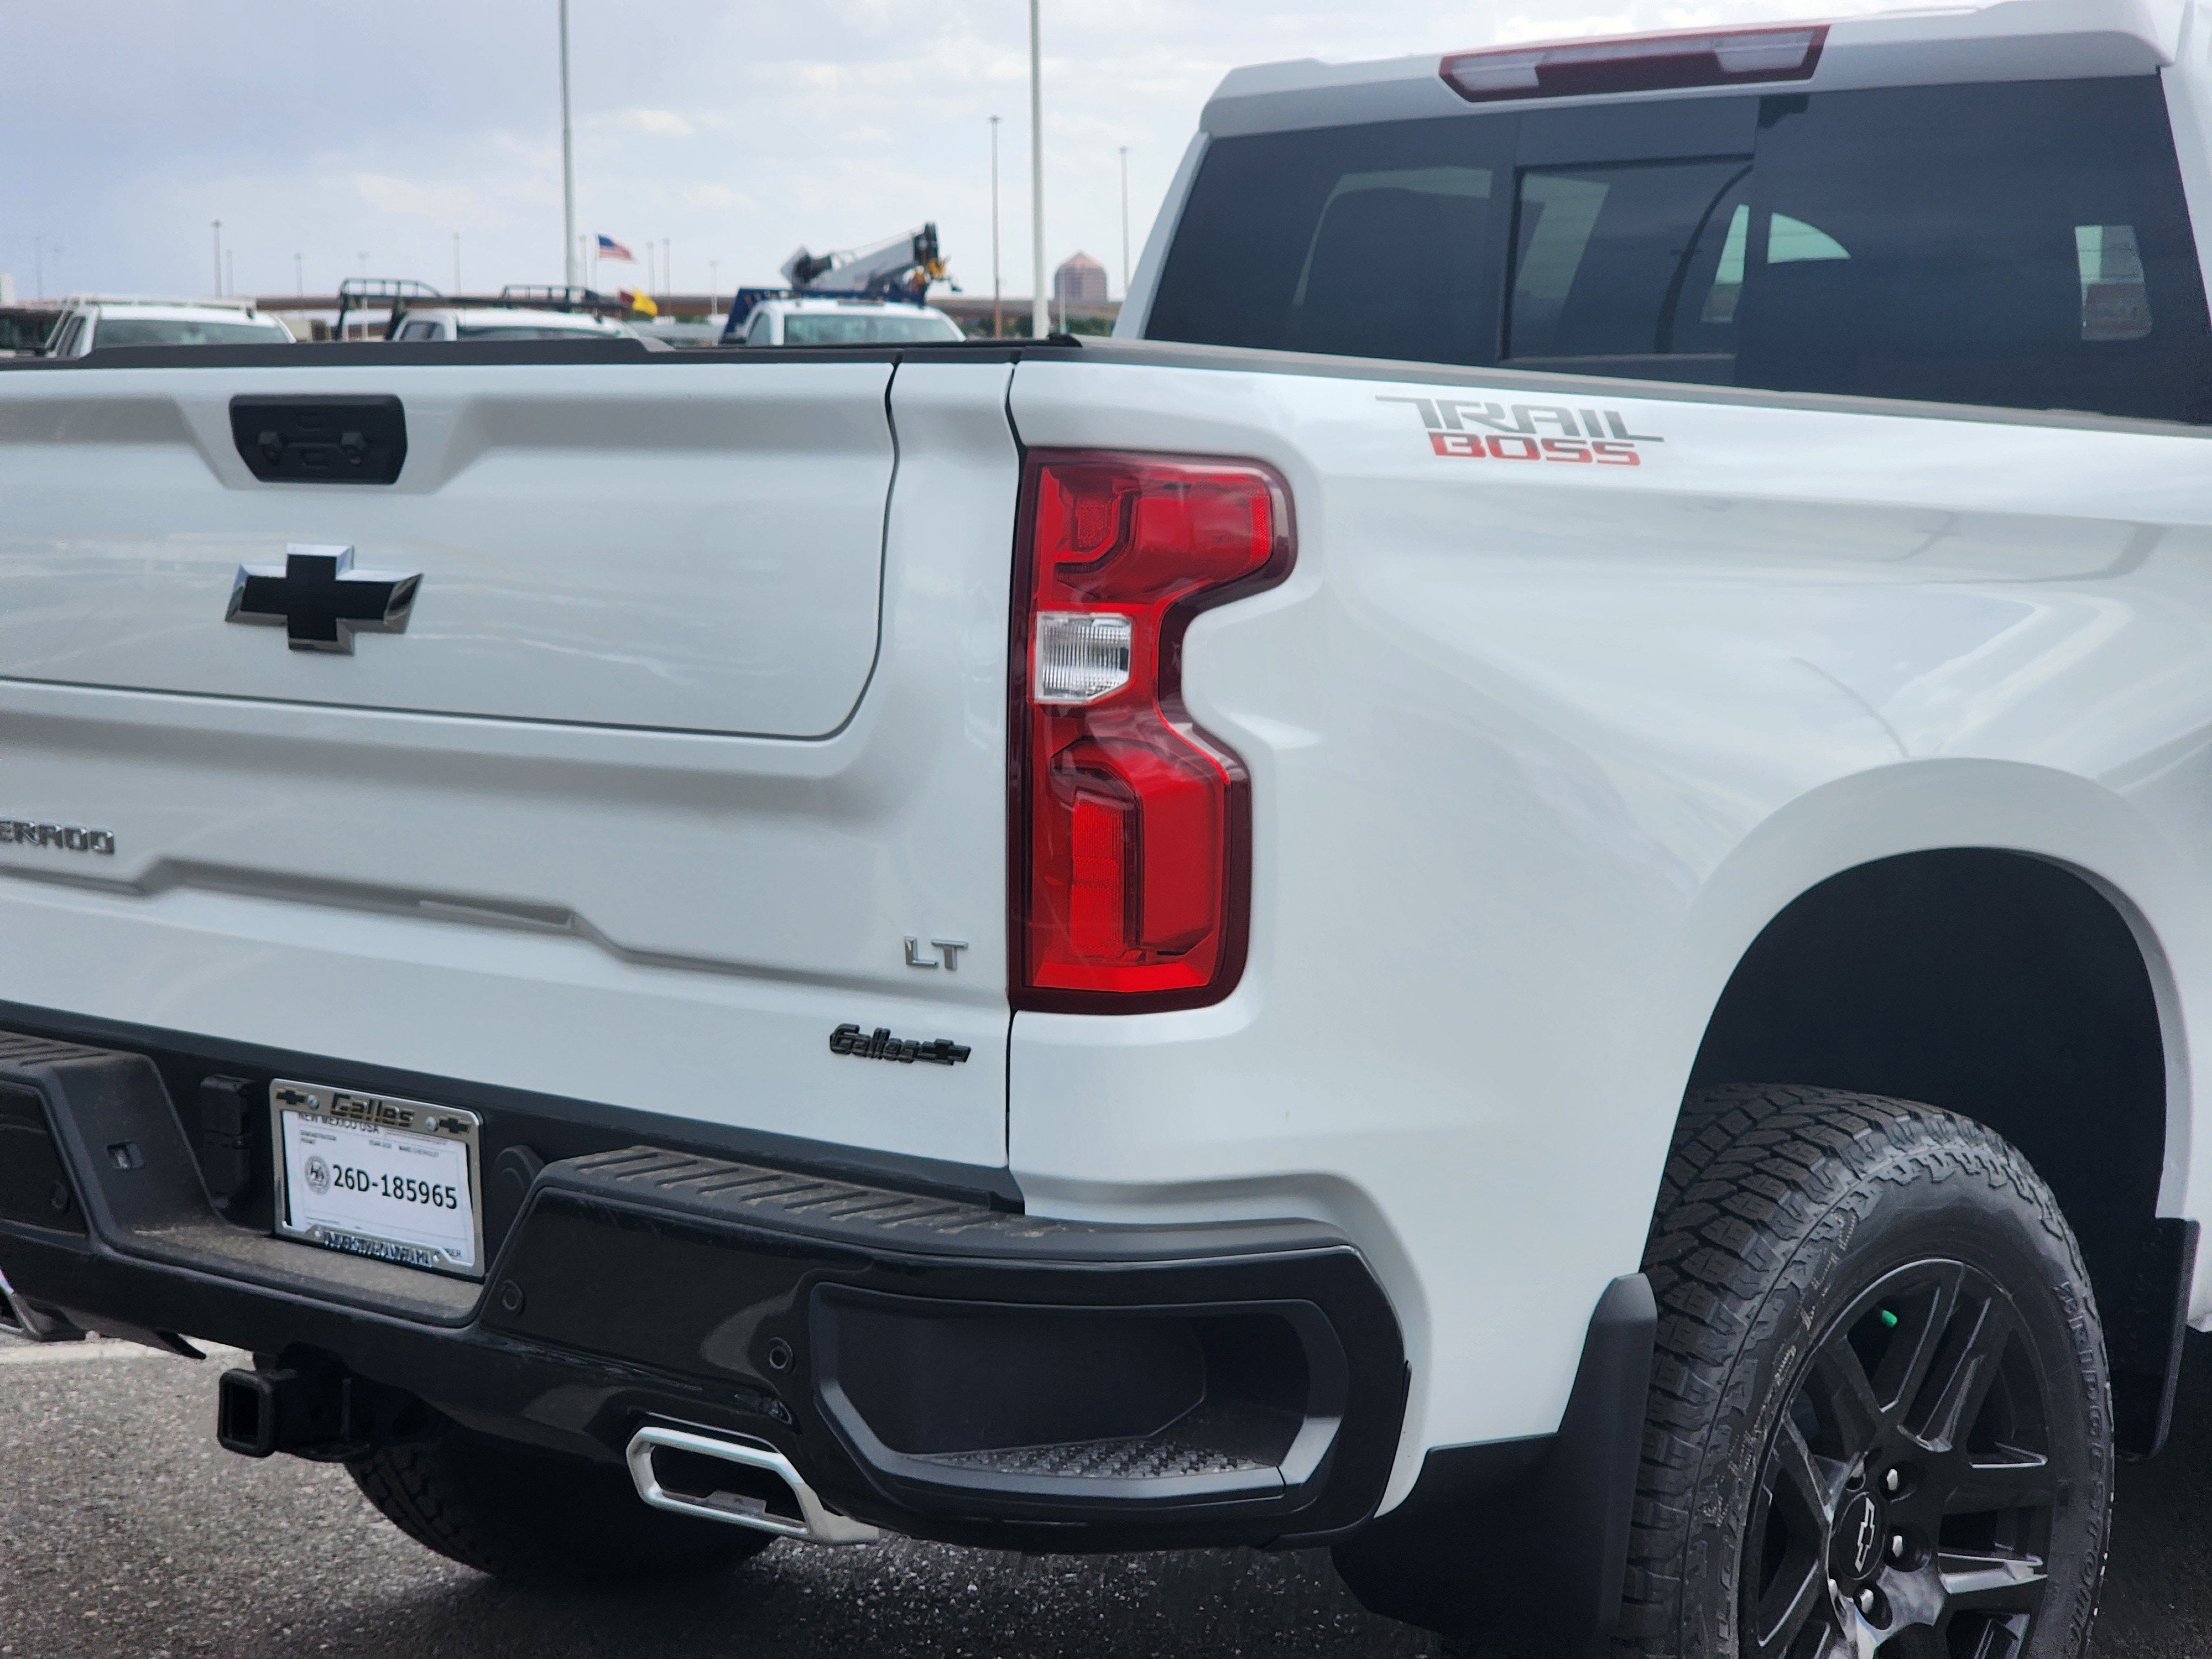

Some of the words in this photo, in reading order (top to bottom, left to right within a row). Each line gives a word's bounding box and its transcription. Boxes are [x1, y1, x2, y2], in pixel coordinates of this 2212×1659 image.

[1375, 395, 1665, 442] TRAIL
[1428, 431, 1641, 466] BOSS
[904, 936, 968, 971] LT
[830, 1023, 920, 1063] Galles
[331, 1092, 414, 1128] Galles
[332, 1164, 458, 1210] 26D-185965
